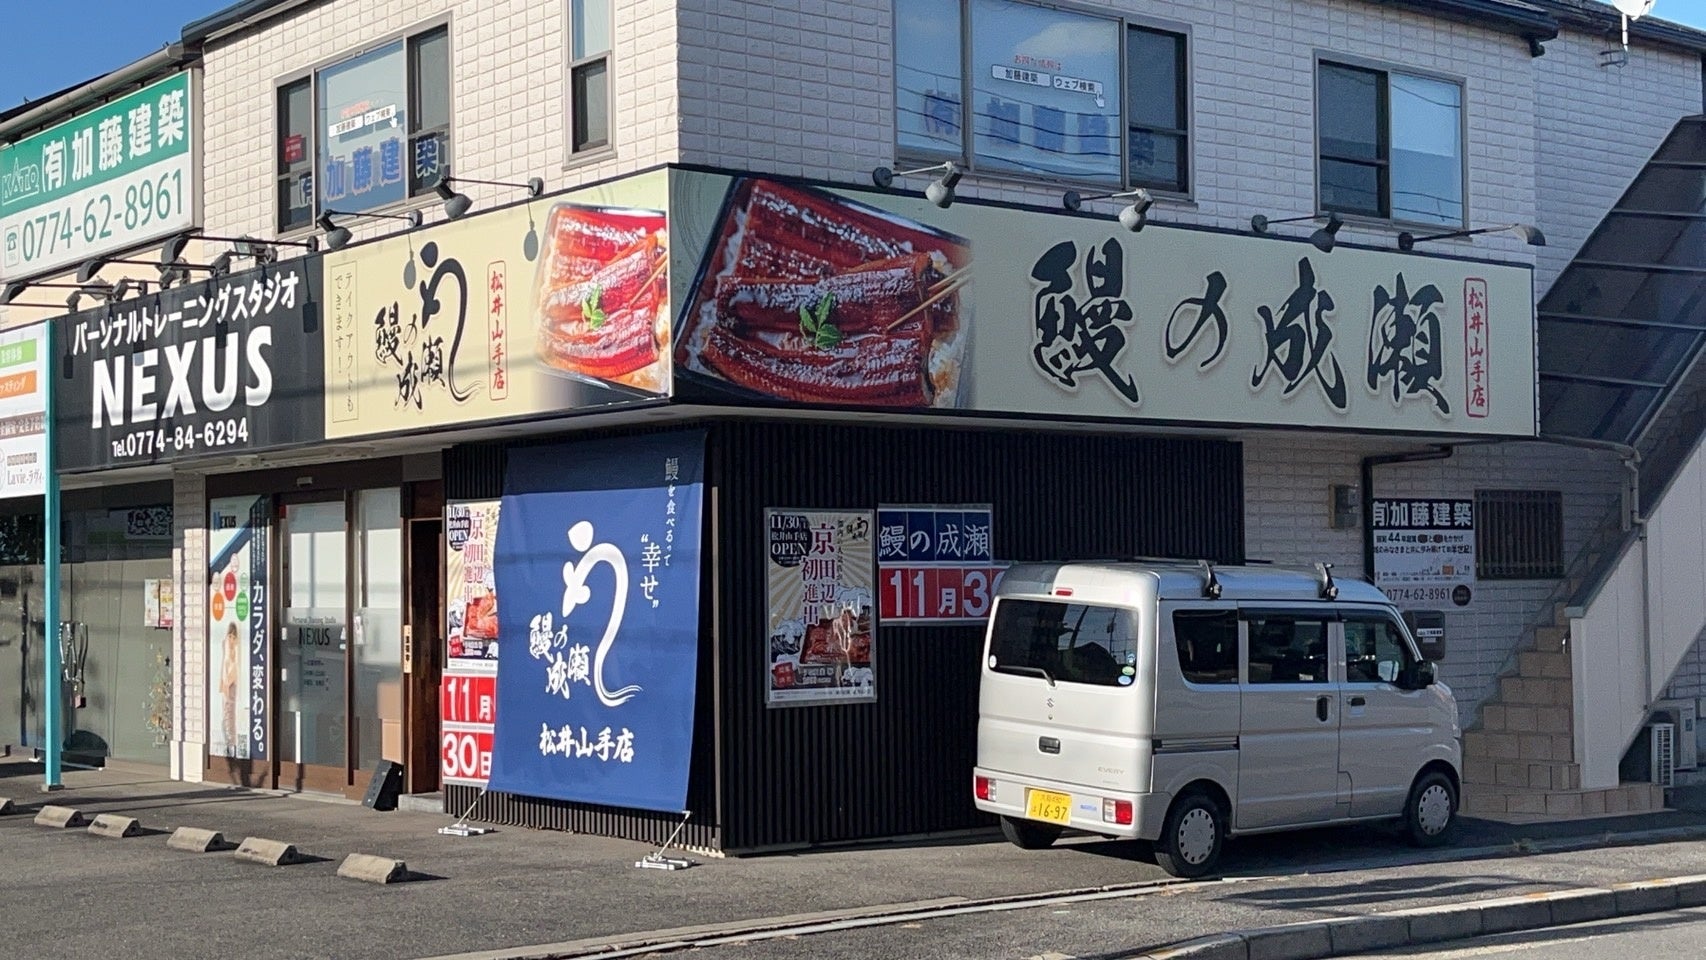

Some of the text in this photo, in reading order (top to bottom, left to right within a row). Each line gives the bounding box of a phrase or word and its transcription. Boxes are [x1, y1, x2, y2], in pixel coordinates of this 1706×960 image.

[1055, 78, 1096, 93] ウェブ検索
[23, 168, 182, 261] 0774-62-8961
[73, 271, 298, 355] パーソナルトレーニングスタジオ
[345, 273, 354, 412] テイクアウトも
[490, 270, 505, 390] 松井山手店
[1031, 237, 1450, 416] 鰻の成瀬
[1468, 287, 1486, 408] 松井山手店
[92, 325, 272, 429] NEXUS
[213, 511, 237, 532] NEXUS
[449, 529, 468, 541] OPEN
[664, 457, 680, 567] 鰻を食べるって
[771, 543, 807, 555] OPEN
[880, 524, 990, 557] 鰻の成瀬
[801, 558, 820, 625] 初進出
[811, 523, 836, 603] 京田辺
[1387, 588, 1451, 601] 0774-62-8961
[252, 580, 265, 752] カラダ、変わる。
[299, 627, 330, 646] NEXUS
[539, 722, 635, 762] 松井山手店
